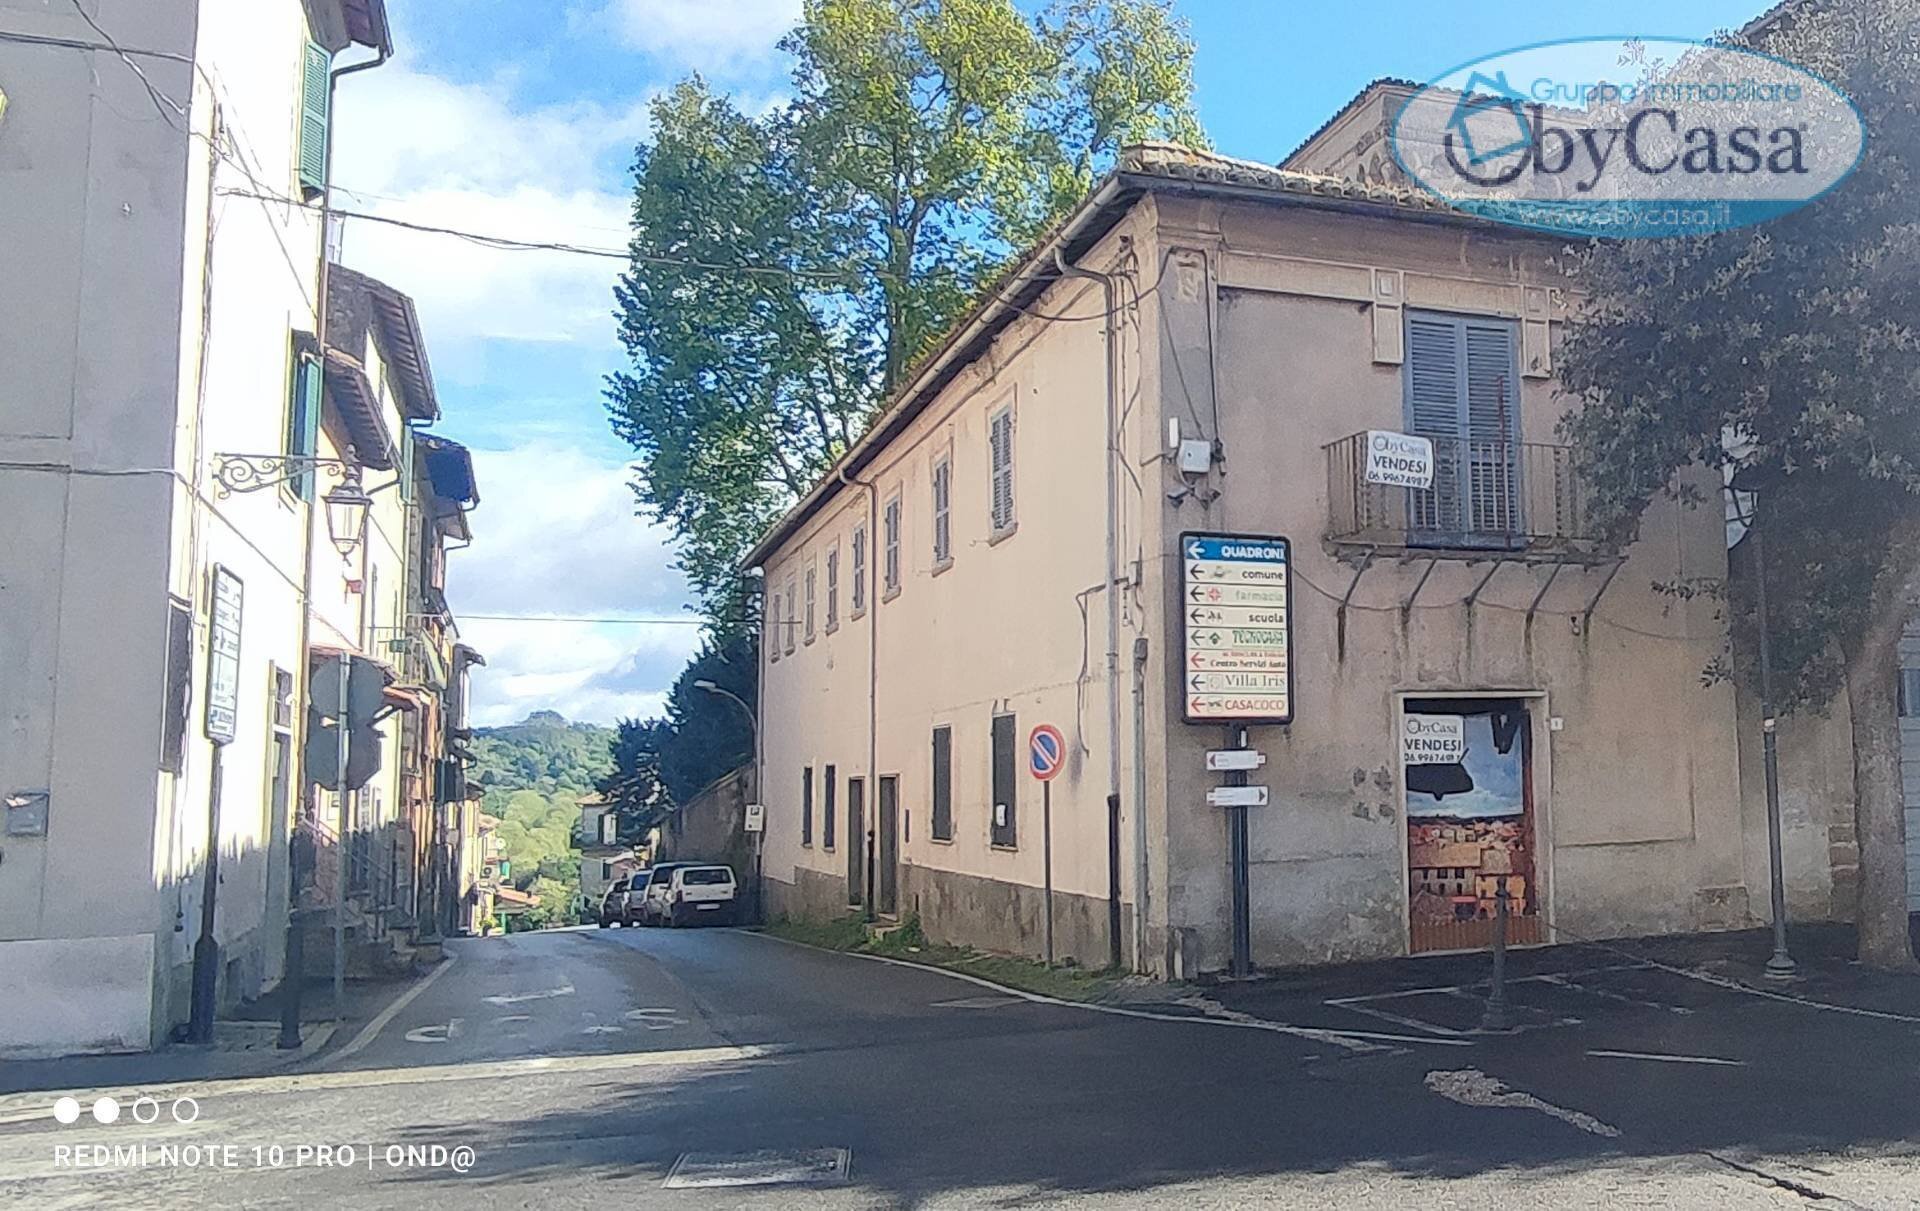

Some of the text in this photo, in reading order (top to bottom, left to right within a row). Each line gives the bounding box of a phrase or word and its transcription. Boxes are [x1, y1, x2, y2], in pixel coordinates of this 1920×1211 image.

[1373, 455, 1427, 474] VENDESI
[1221, 546, 1284, 560] QUADRONI
[1242, 570, 1284, 581] comune
[1236, 589, 1283, 602] farmacia
[1249, 613, 1284, 624] scuola
[1210, 660, 1238, 668] Centro
[1225, 674, 1285, 688] Villa Iris
[1225, 700, 1285, 711] CASACOCO
[1404, 738, 1461, 752] VENDESI
